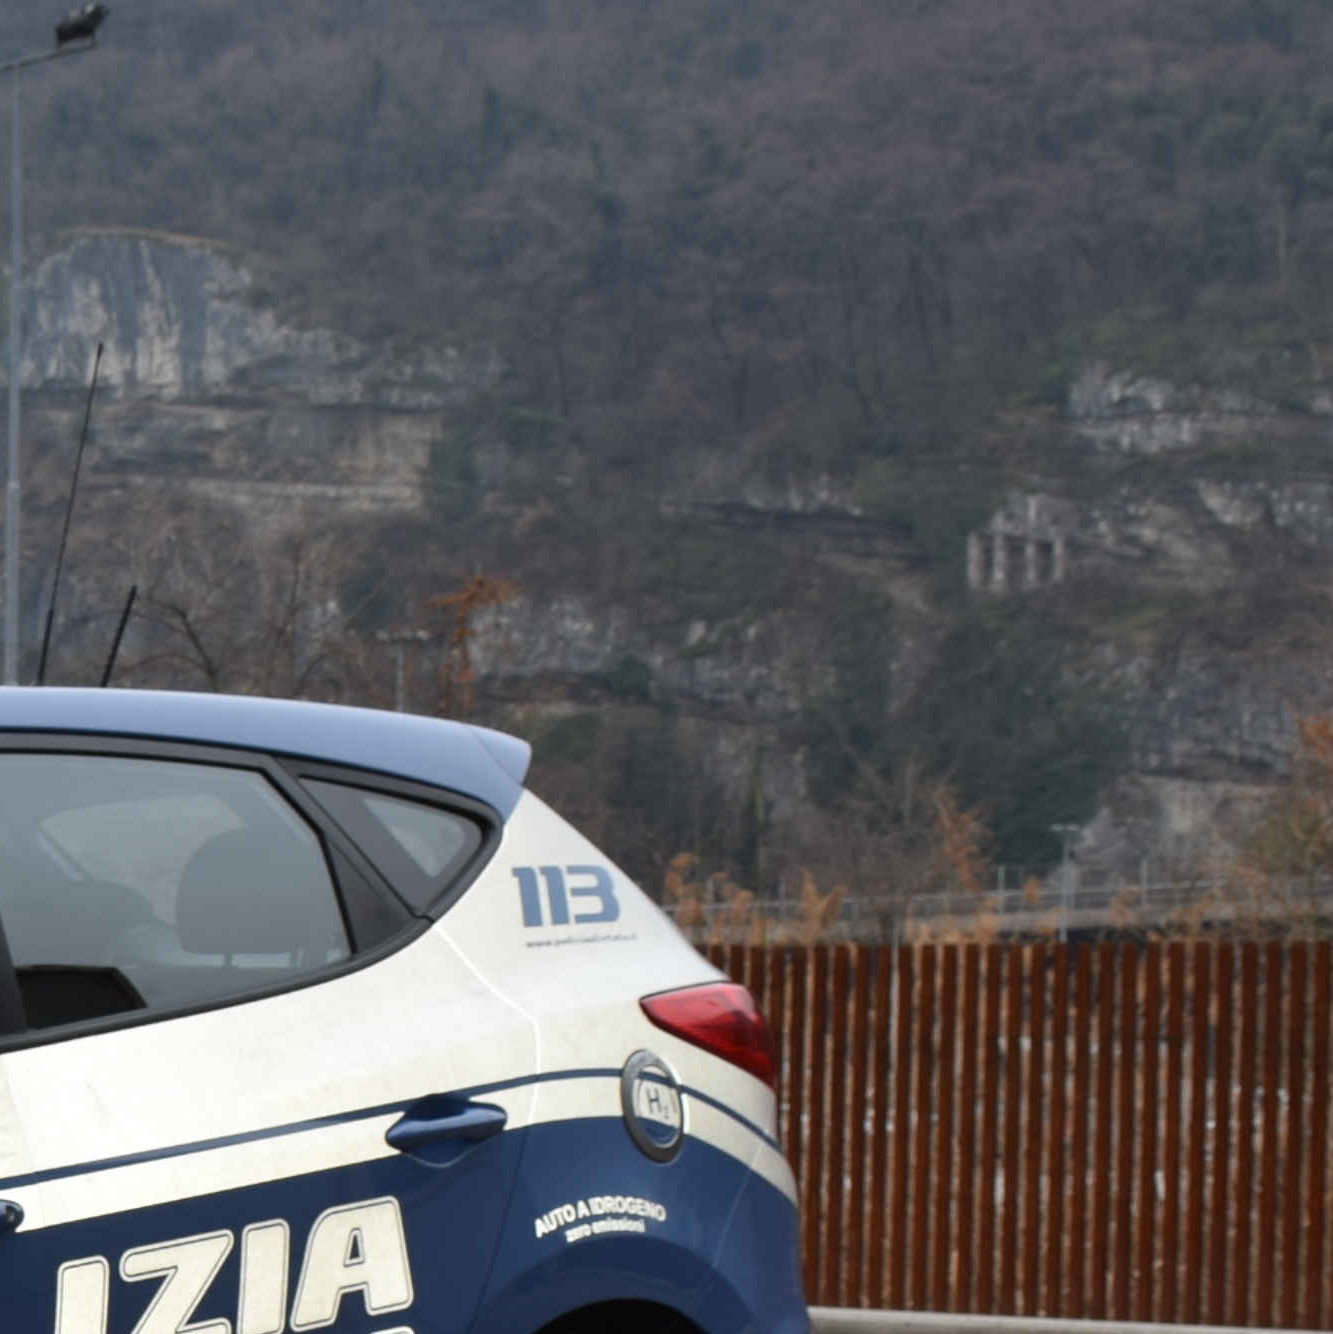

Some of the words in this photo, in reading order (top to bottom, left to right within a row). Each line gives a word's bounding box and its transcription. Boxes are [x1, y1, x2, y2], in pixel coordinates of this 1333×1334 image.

[511, 865, 621, 928] 113
[534, 1203, 576, 1238] AUTO
[577, 1199, 591, 1219] A
[589, 1195, 667, 1222] IDROGENO
